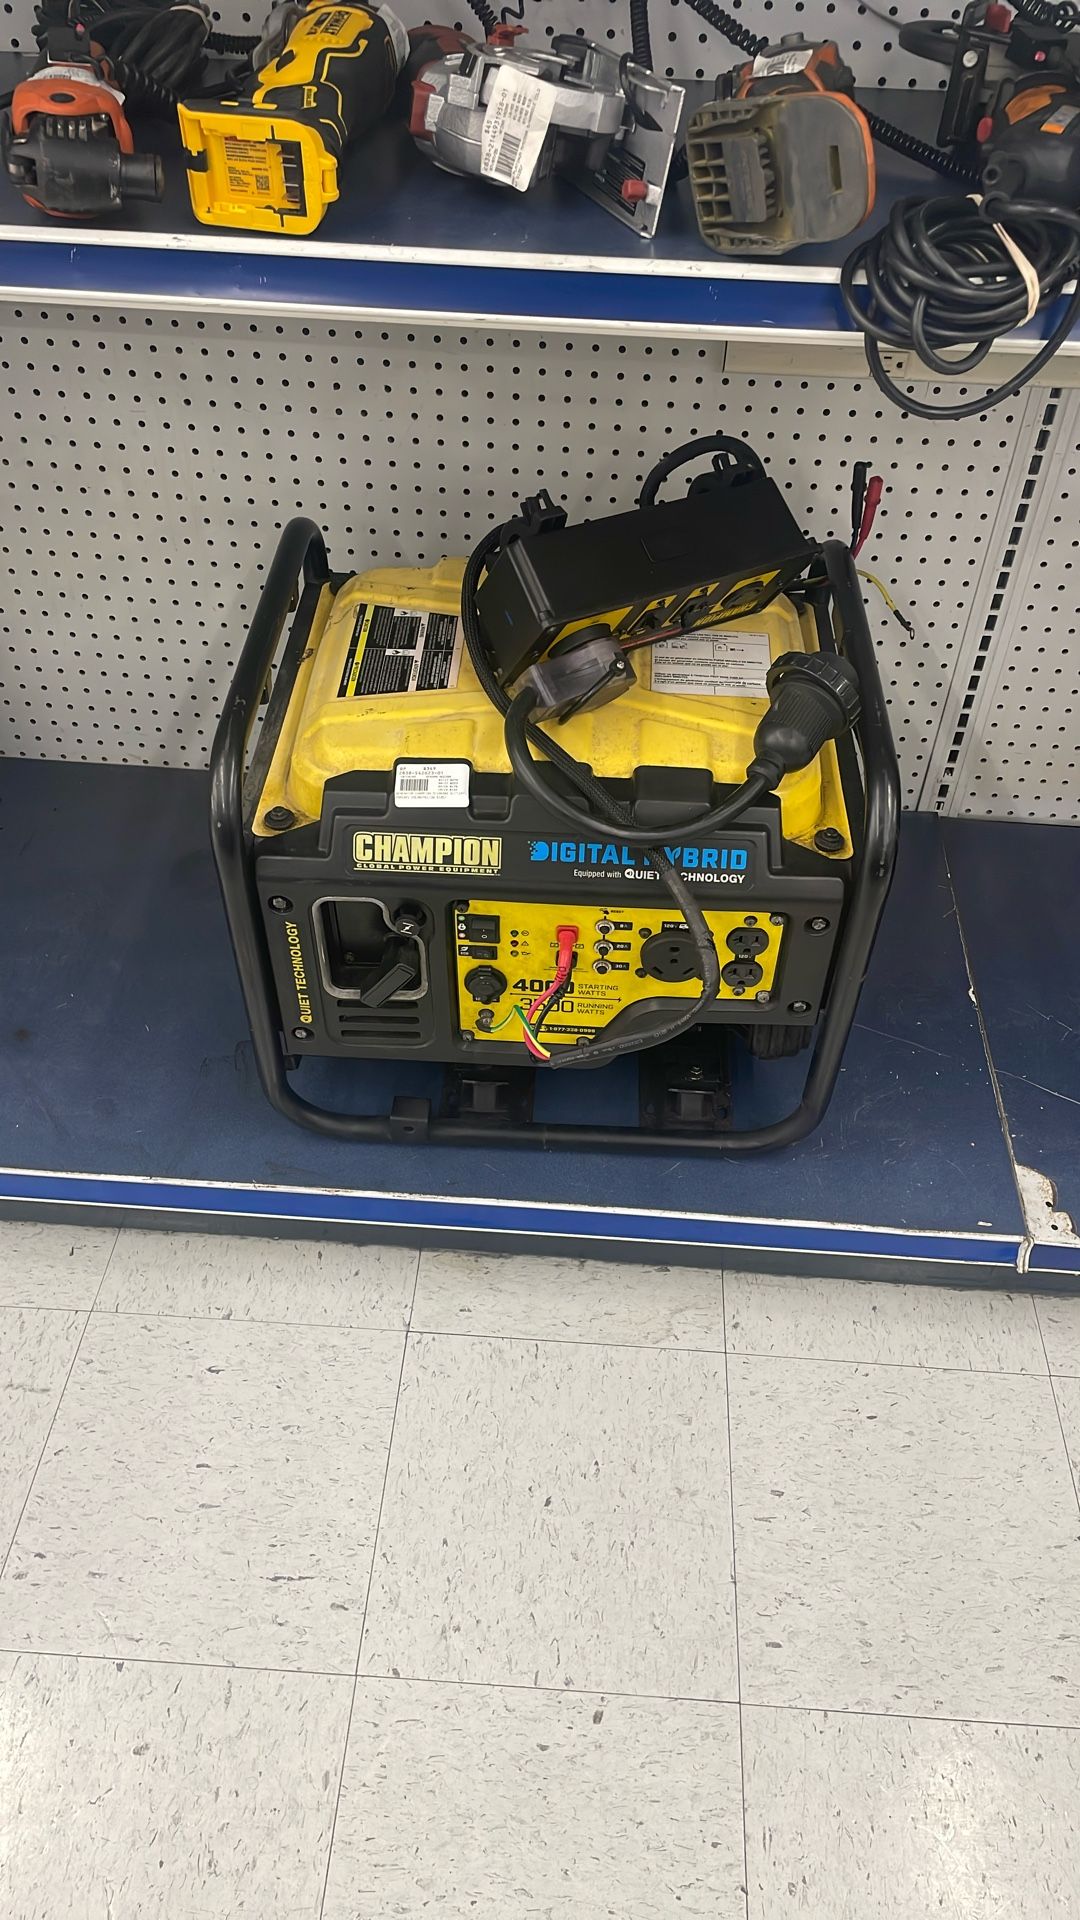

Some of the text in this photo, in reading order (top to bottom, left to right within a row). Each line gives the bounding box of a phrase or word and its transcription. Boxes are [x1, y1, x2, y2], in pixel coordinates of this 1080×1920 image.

[484, 120, 493, 134] $45
[354, 832, 501, 867] CHAMPION
[529, 841, 748, 870] DIGITAL YBRID
[573, 868, 605, 879] Equipped
[606, 870, 622, 878] with
[285, 921, 313, 1024] QUIET TECHNOLOGY
